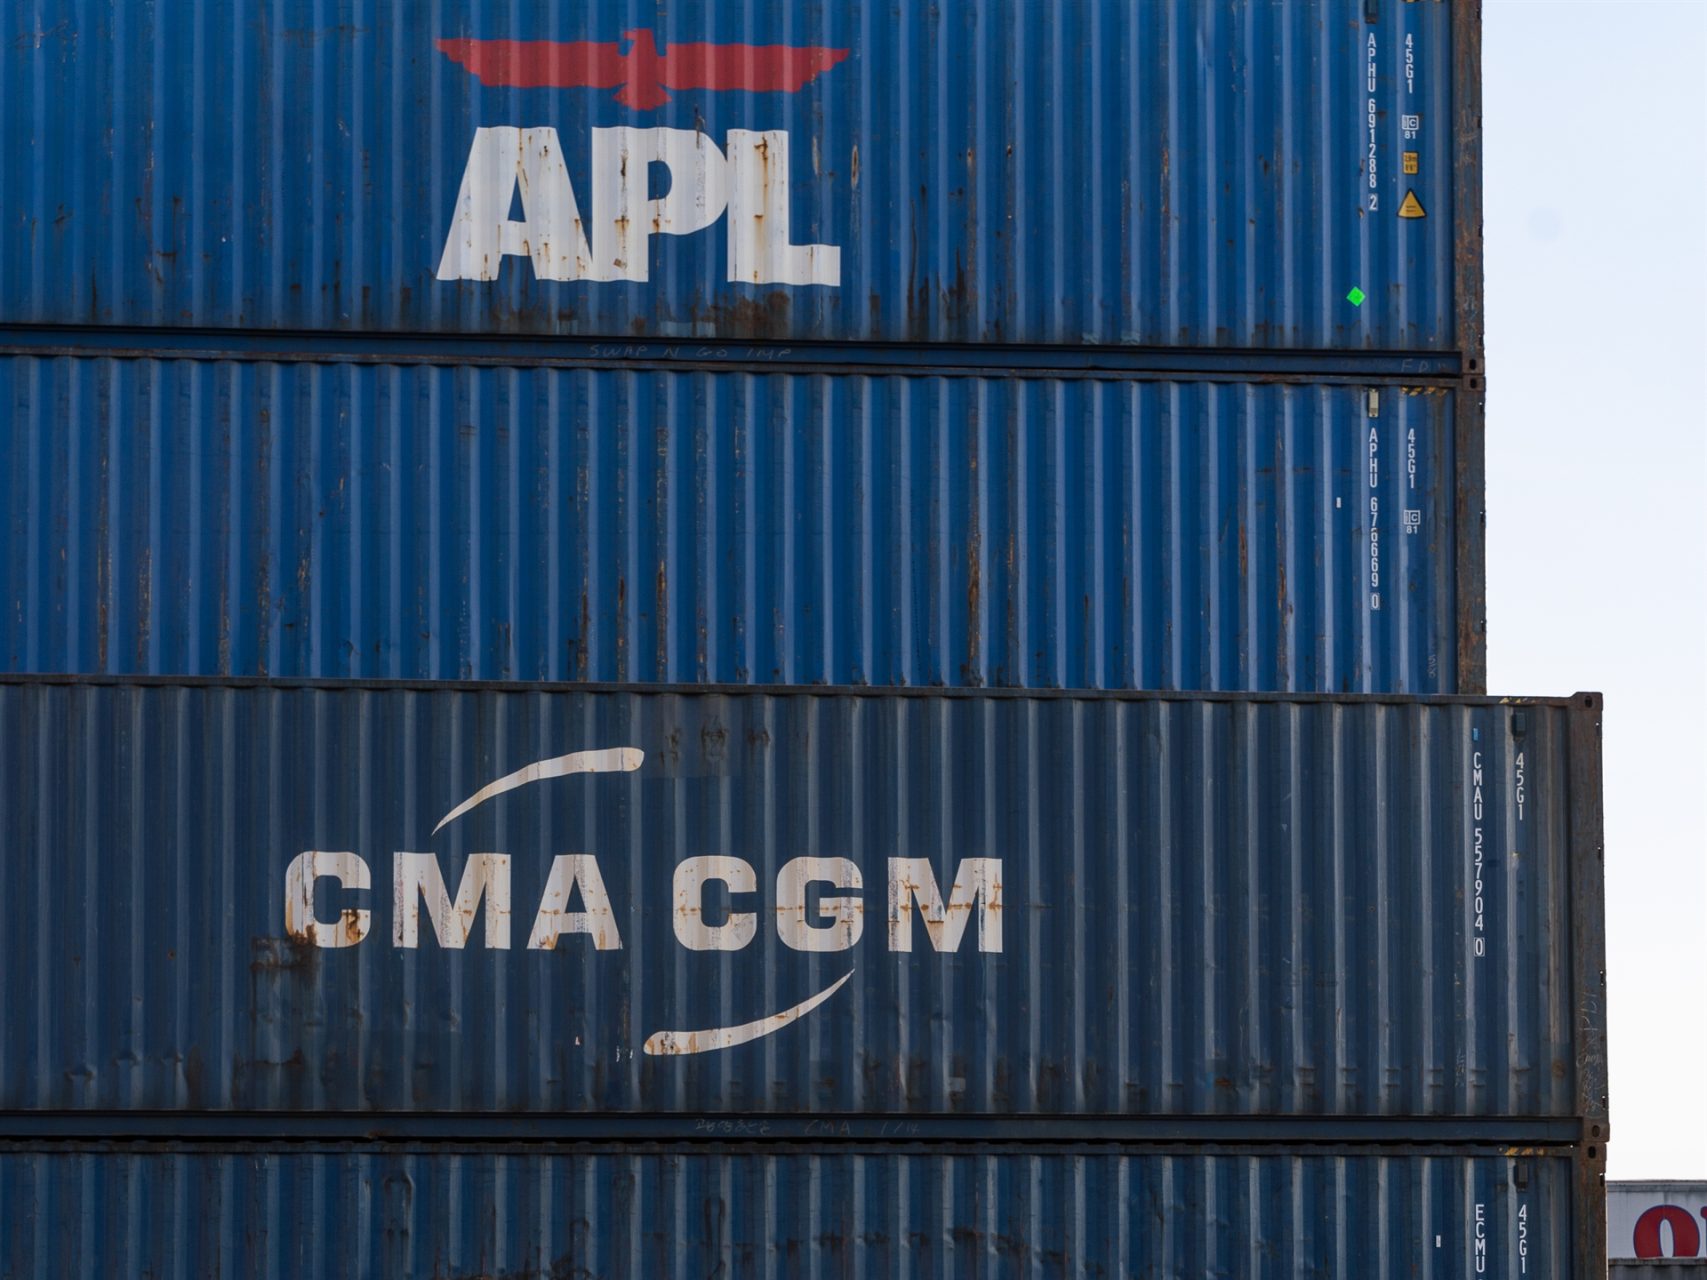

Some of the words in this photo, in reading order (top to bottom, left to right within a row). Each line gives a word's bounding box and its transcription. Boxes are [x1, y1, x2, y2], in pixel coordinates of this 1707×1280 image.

[1367, 32, 1377, 92] APHU
[1405, 33, 1414, 93] 45G1
[1368, 98, 1378, 189] 691288
[1404, 131, 1416, 139] 81
[436, 126, 841, 287] APL
[1369, 193, 1378, 211] 2
[589, 344, 648, 358] SWAP
[1369, 427, 1378, 488] APHU
[1407, 428, 1416, 488] 45G1
[1370, 497, 1379, 587] 676669
[1406, 526, 1418, 534] 81
[1371, 592, 1380, 610] 0
[1473, 752, 1482, 820] CMAU
[1515, 752, 1525, 821] 45G1
[285, 850, 623, 951] CMA
[673, 855, 1003, 953] CGM
[1474, 828, 1483, 931] 557904
[1474, 938, 1485, 957] 0
[1475, 1204, 1485, 1273] ECMU
[1518, 1204, 1527, 1274] 45G1
